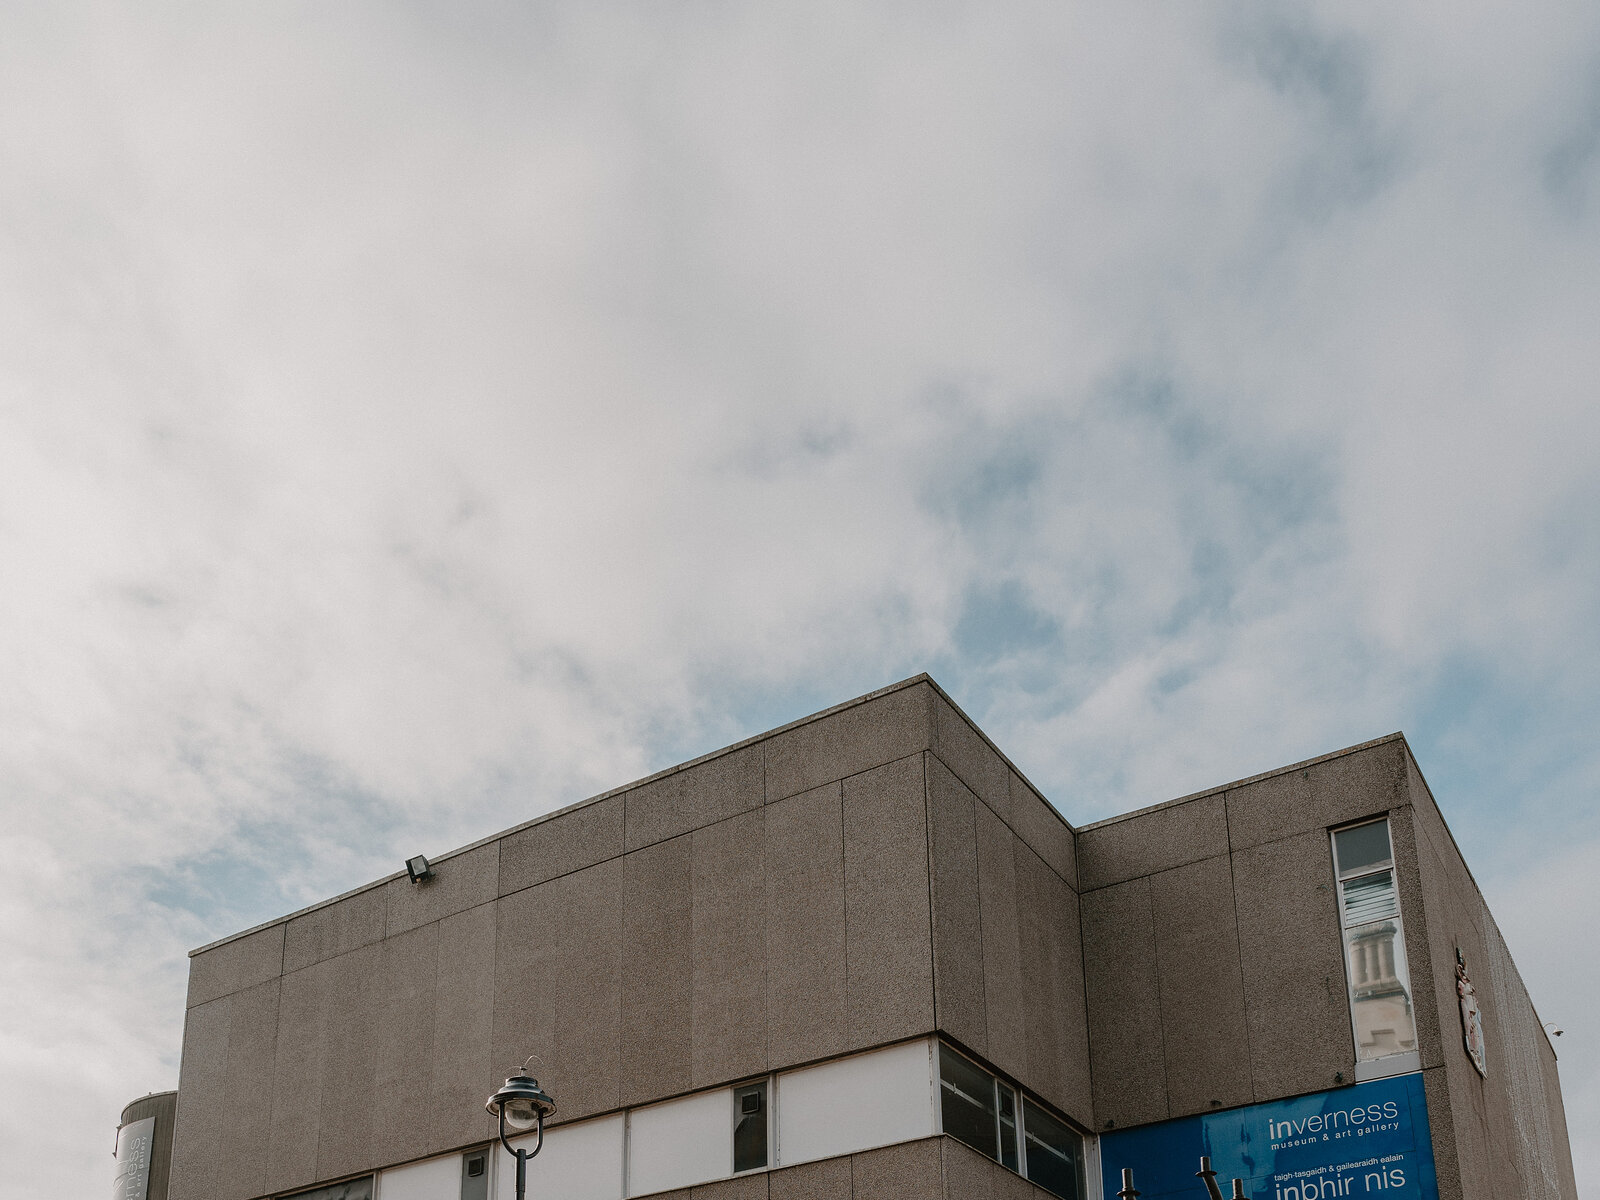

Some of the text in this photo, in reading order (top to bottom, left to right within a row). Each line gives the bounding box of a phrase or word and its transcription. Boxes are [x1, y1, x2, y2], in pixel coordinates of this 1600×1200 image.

[1269, 1101, 1398, 1140] inverness
[1271, 1122, 1399, 1151] museum & art gallery
[139, 1136, 148, 1170] gallery
[1274, 1153, 1404, 1182] taigh-tasgaidh & gailearaidh ealain
[1365, 1165, 1406, 1192] nis
